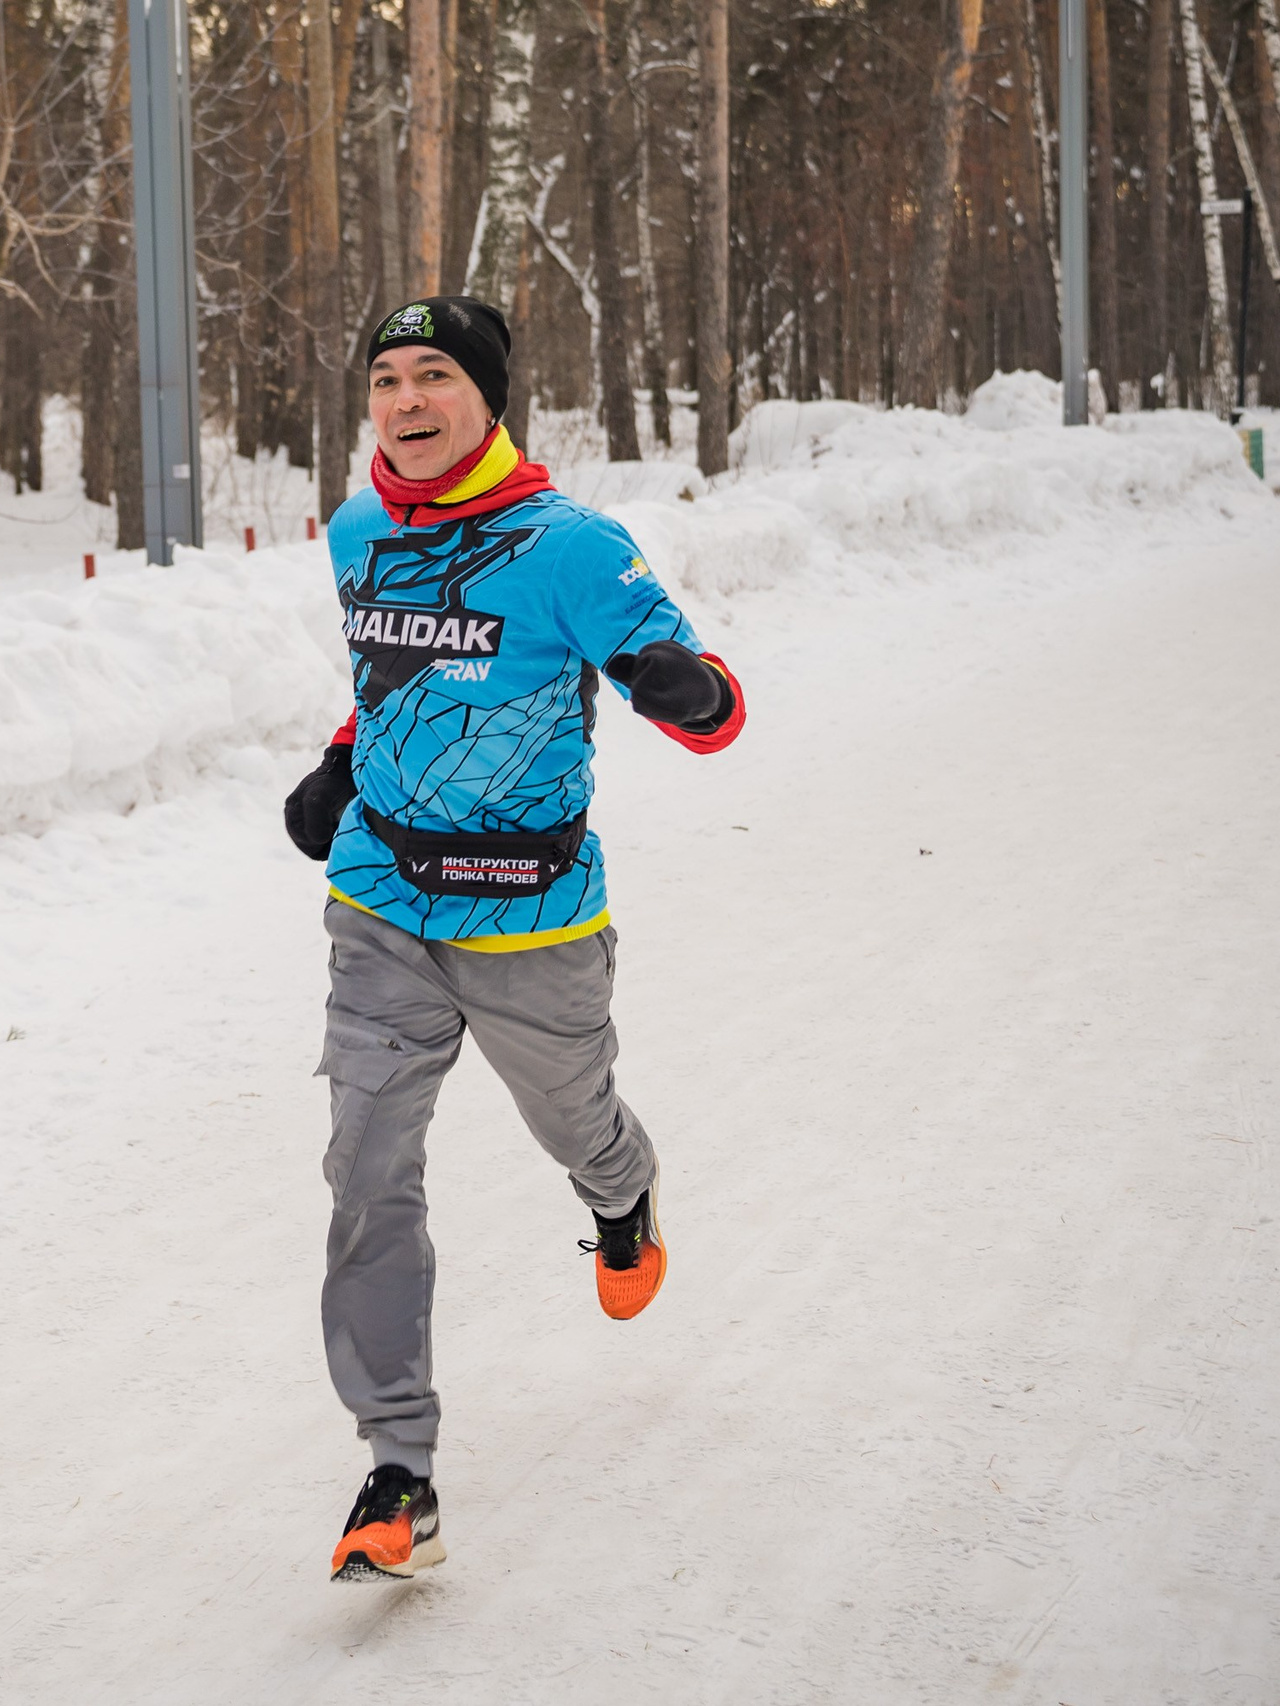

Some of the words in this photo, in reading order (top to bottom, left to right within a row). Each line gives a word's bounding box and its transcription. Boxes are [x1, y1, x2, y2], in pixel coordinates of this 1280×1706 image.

[344, 604, 499, 652] MALIDAK
[442, 856, 539, 870] ИНСТРУКТОР
[442, 870, 485, 881] ГОНКА
[488, 872, 538, 884] ГЕРОЕВ
